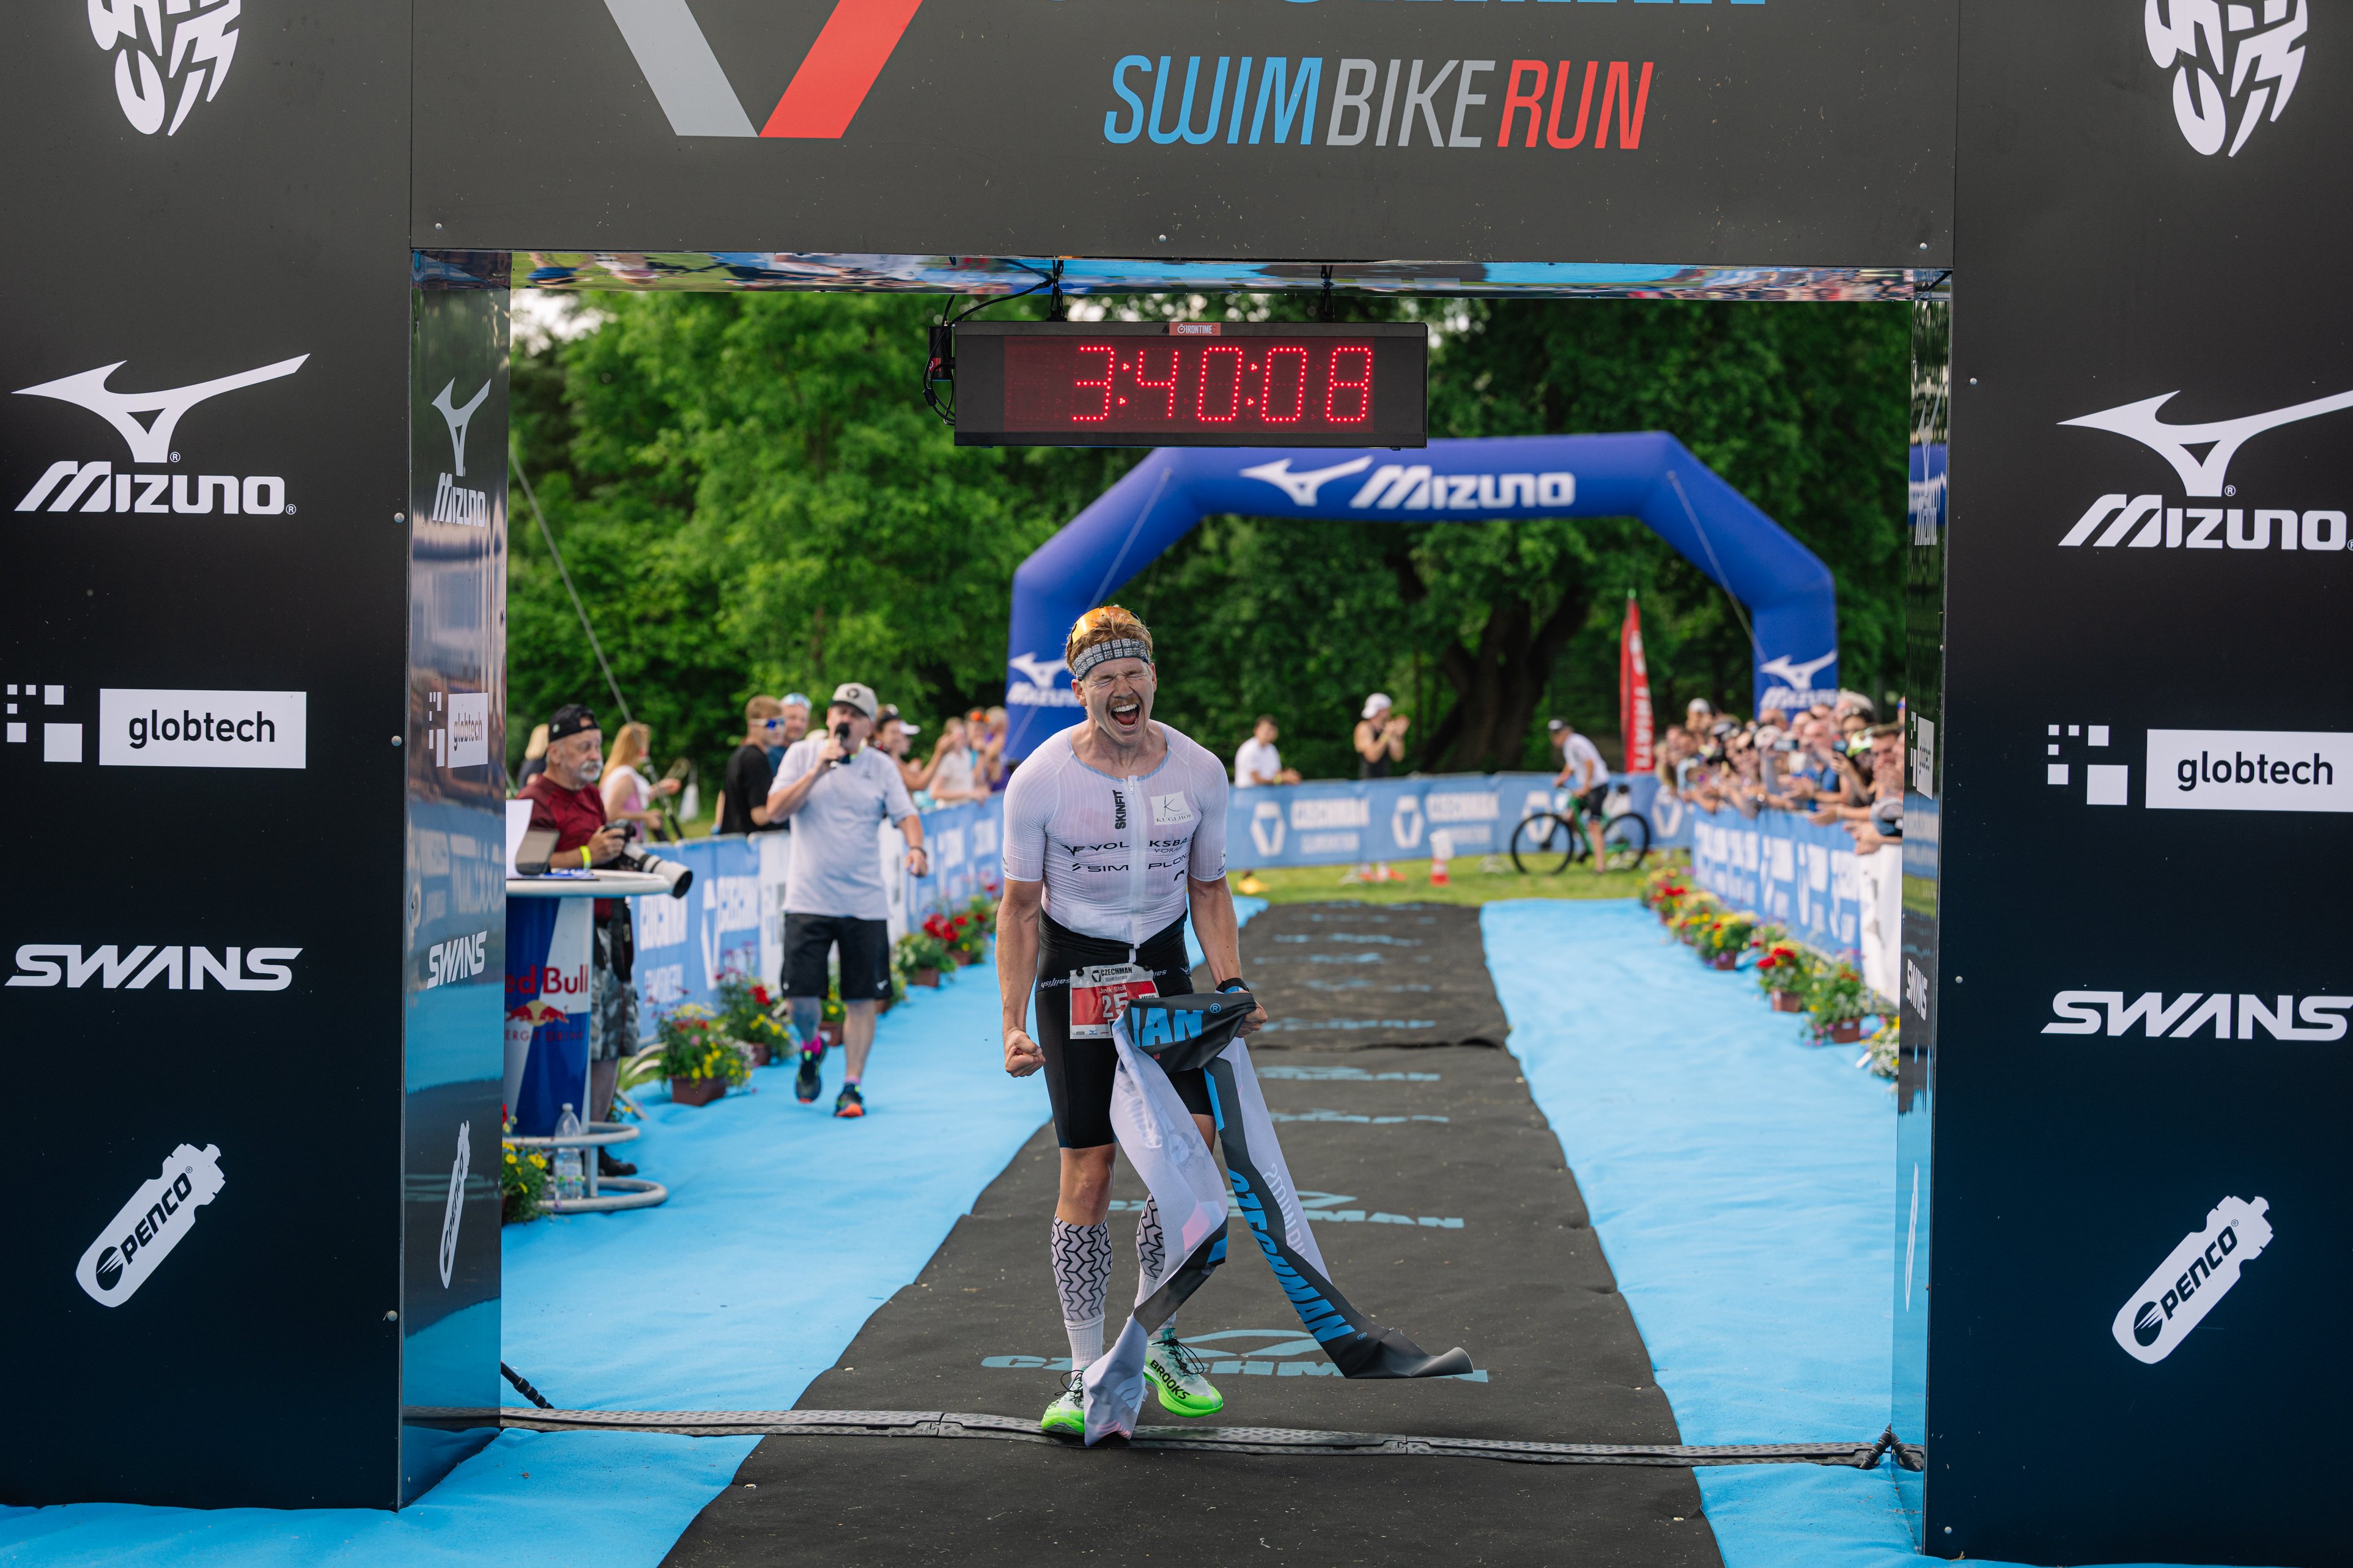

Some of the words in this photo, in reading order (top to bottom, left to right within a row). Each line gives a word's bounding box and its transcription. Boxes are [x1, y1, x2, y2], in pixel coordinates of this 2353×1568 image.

[1186, 325, 1212, 334] IRONTIME
[1071, 345, 1373, 422] 3:40:08
[14, 462, 286, 514] MIZUNO
[432, 472, 486, 528] MIZUNO
[1348, 466, 1576, 510] MIZUNO
[2058, 494, 2347, 551] MIZUNO
[128, 710, 276, 749] globtech
[453, 711, 482, 751] globtech
[2178, 751, 2333, 792] globtech
[1112, 789, 1126, 830] SKINFIT
[5, 944, 304, 991] SWANS
[427, 930, 487, 990] SWANS
[506, 964, 536, 994] ed
[542, 964, 589, 995] Bull
[1101, 966, 1132, 976] CZECHMAN
[1102, 992, 1129, 1018] 25
[2040, 990, 2353, 1042] SWANS
[120, 1172, 193, 1265] PENCO
[448, 1150, 464, 1244] PENCO
[2159, 1225, 2238, 1321] PENCO
[1150, 1359, 1191, 1400] BROOKS
